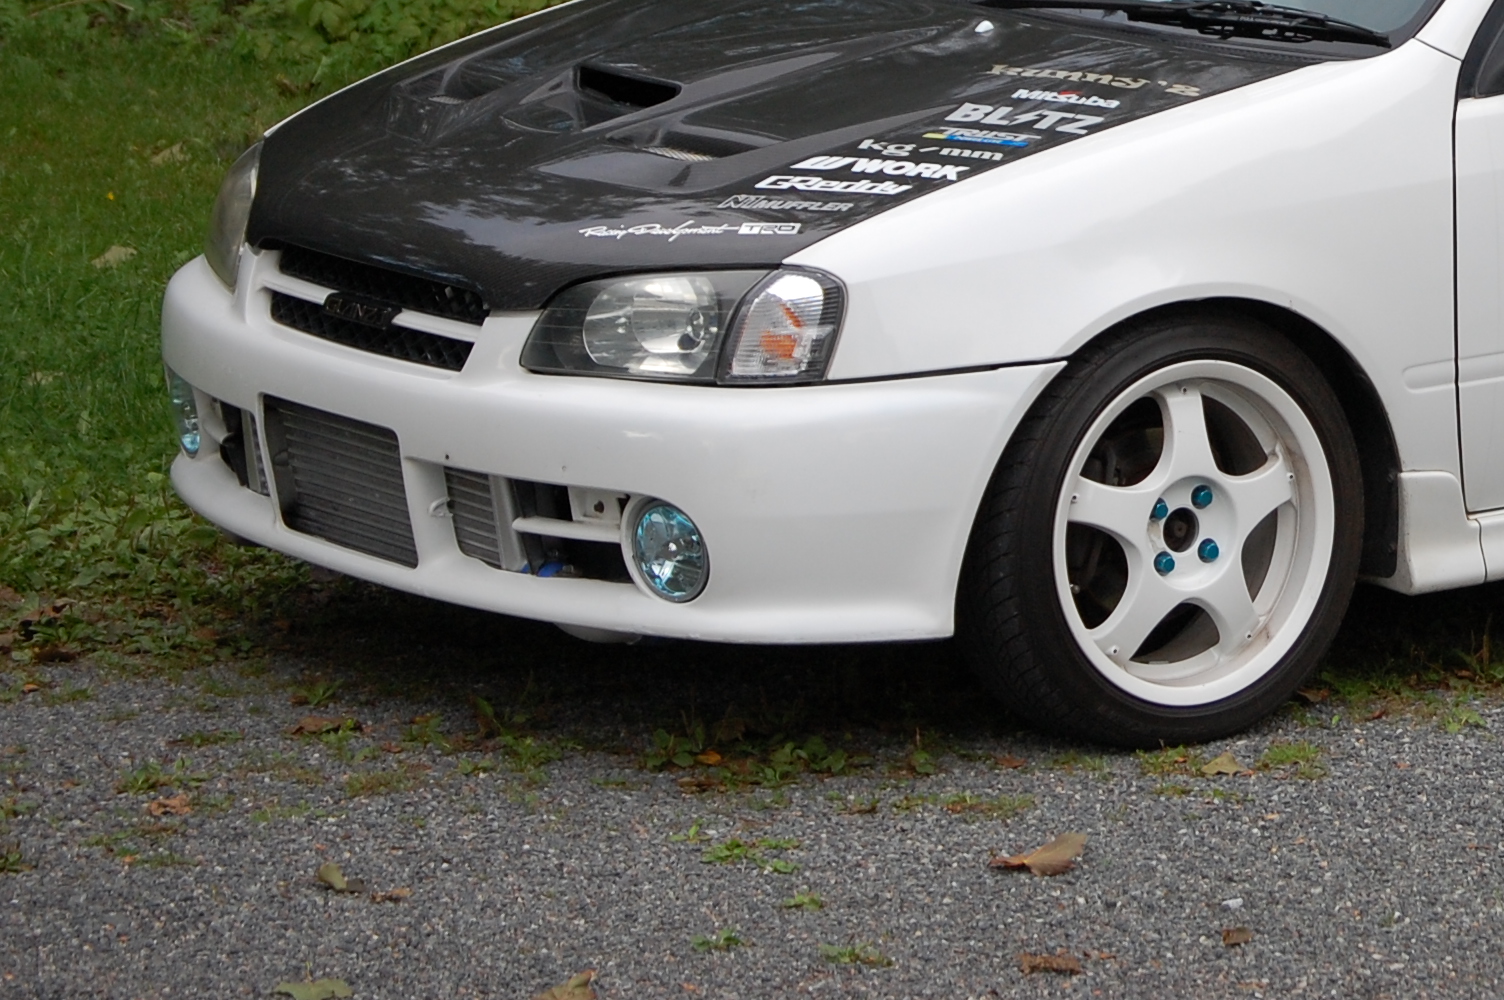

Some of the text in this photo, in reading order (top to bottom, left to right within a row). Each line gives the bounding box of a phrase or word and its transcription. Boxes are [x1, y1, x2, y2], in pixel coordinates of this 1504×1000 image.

[944, 102, 1105, 135] BLITZ
[939, 126, 1042, 142] TRUST
[752, 198, 854, 212] MUFFLER
[742, 223, 799, 235] TRD
